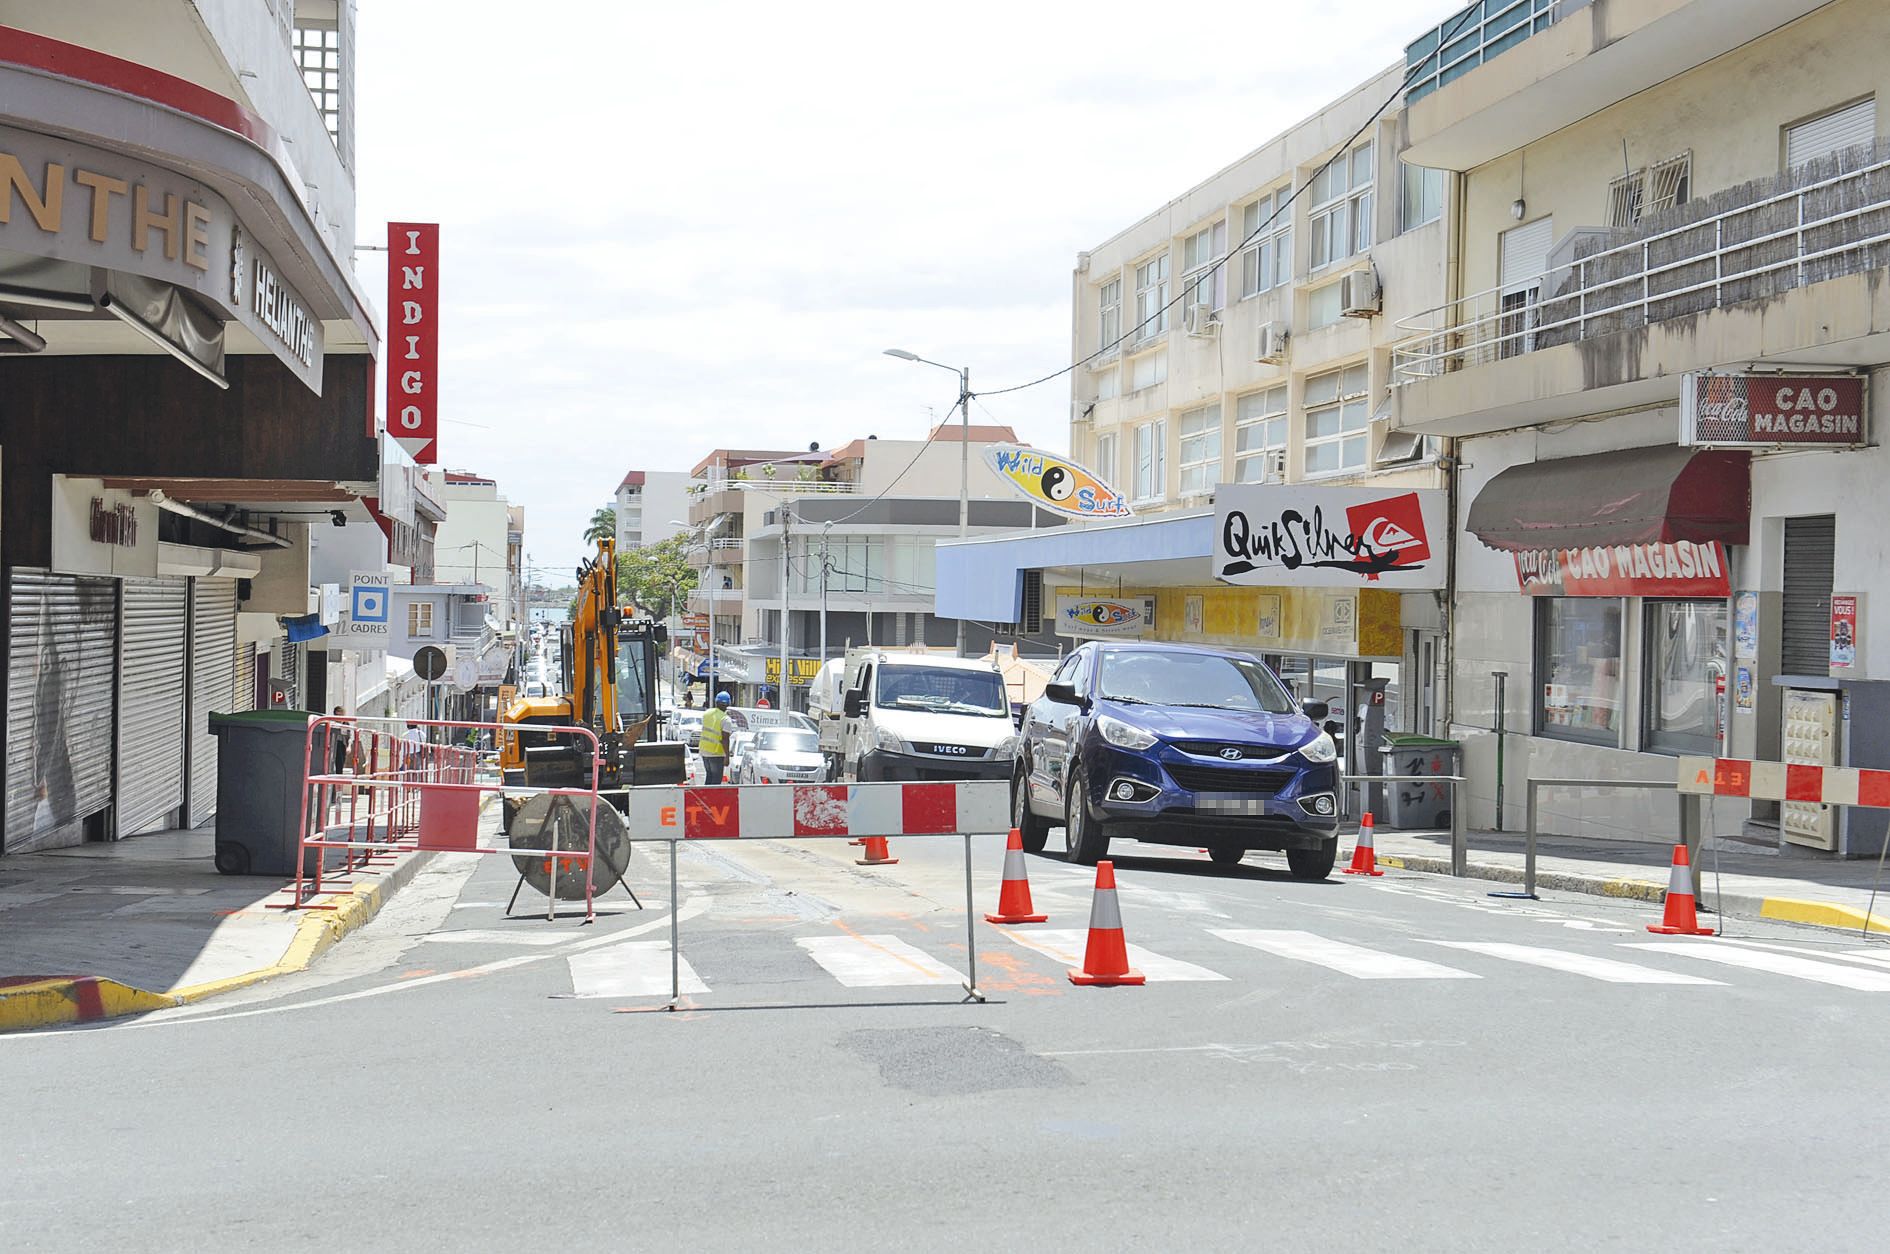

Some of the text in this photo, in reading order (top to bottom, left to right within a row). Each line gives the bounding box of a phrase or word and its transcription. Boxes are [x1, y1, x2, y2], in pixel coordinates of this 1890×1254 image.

[401, 230, 425, 430] INDIGO
[1775, 387, 1838, 411] CAO
[1754, 413, 1858, 434] MAGASIN
[996, 450, 1124, 514] Wild Surf
[1566, 547, 1611, 580] CAO
[1615, 540, 1722, 580] MAGASIN
[354, 574, 389, 585] POINT
[350, 623, 388, 634] CADRES
[275, 691, 283, 703] P
[1374, 692, 1383, 704] P
[933, 745, 967, 755] IVECO
[660, 805, 730, 826] ETV
